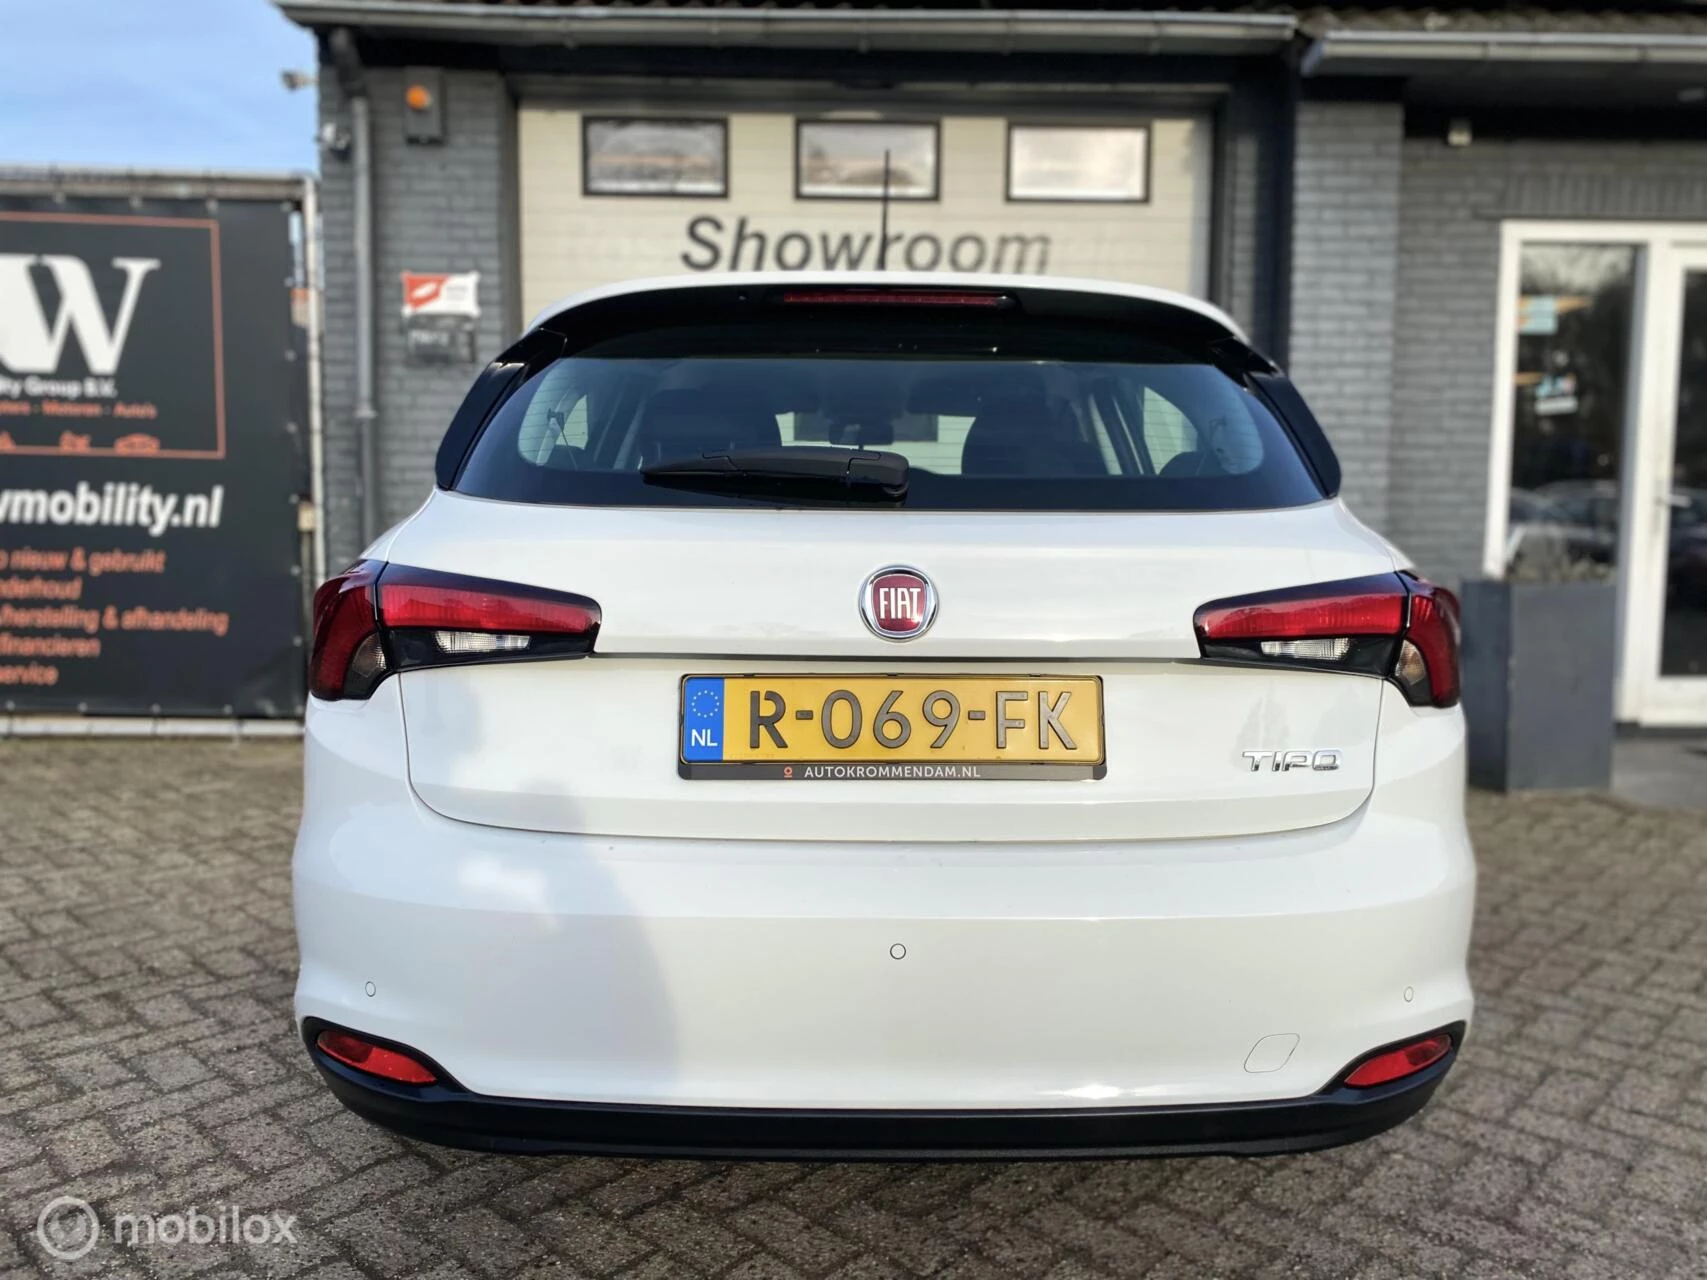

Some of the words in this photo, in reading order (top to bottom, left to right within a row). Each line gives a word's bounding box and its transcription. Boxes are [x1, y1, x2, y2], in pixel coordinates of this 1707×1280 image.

[680, 215, 1053, 274] Showroom
[24, 375, 82, 400] Group
[70, 547, 86, 571] &
[89, 549, 166, 576] gebruikt
[879, 587, 921, 621] FIAT
[0, 604, 99, 633] herstelling
[103, 605, 118, 630] &
[121, 606, 230, 636] afhandeling
[749, 689, 1077, 750] R-069-FK
[691, 728, 718, 748] NL
[804, 766, 981, 778] AUTOKROMMENDAM.NL
[1242, 750, 1341, 772] TIPO
